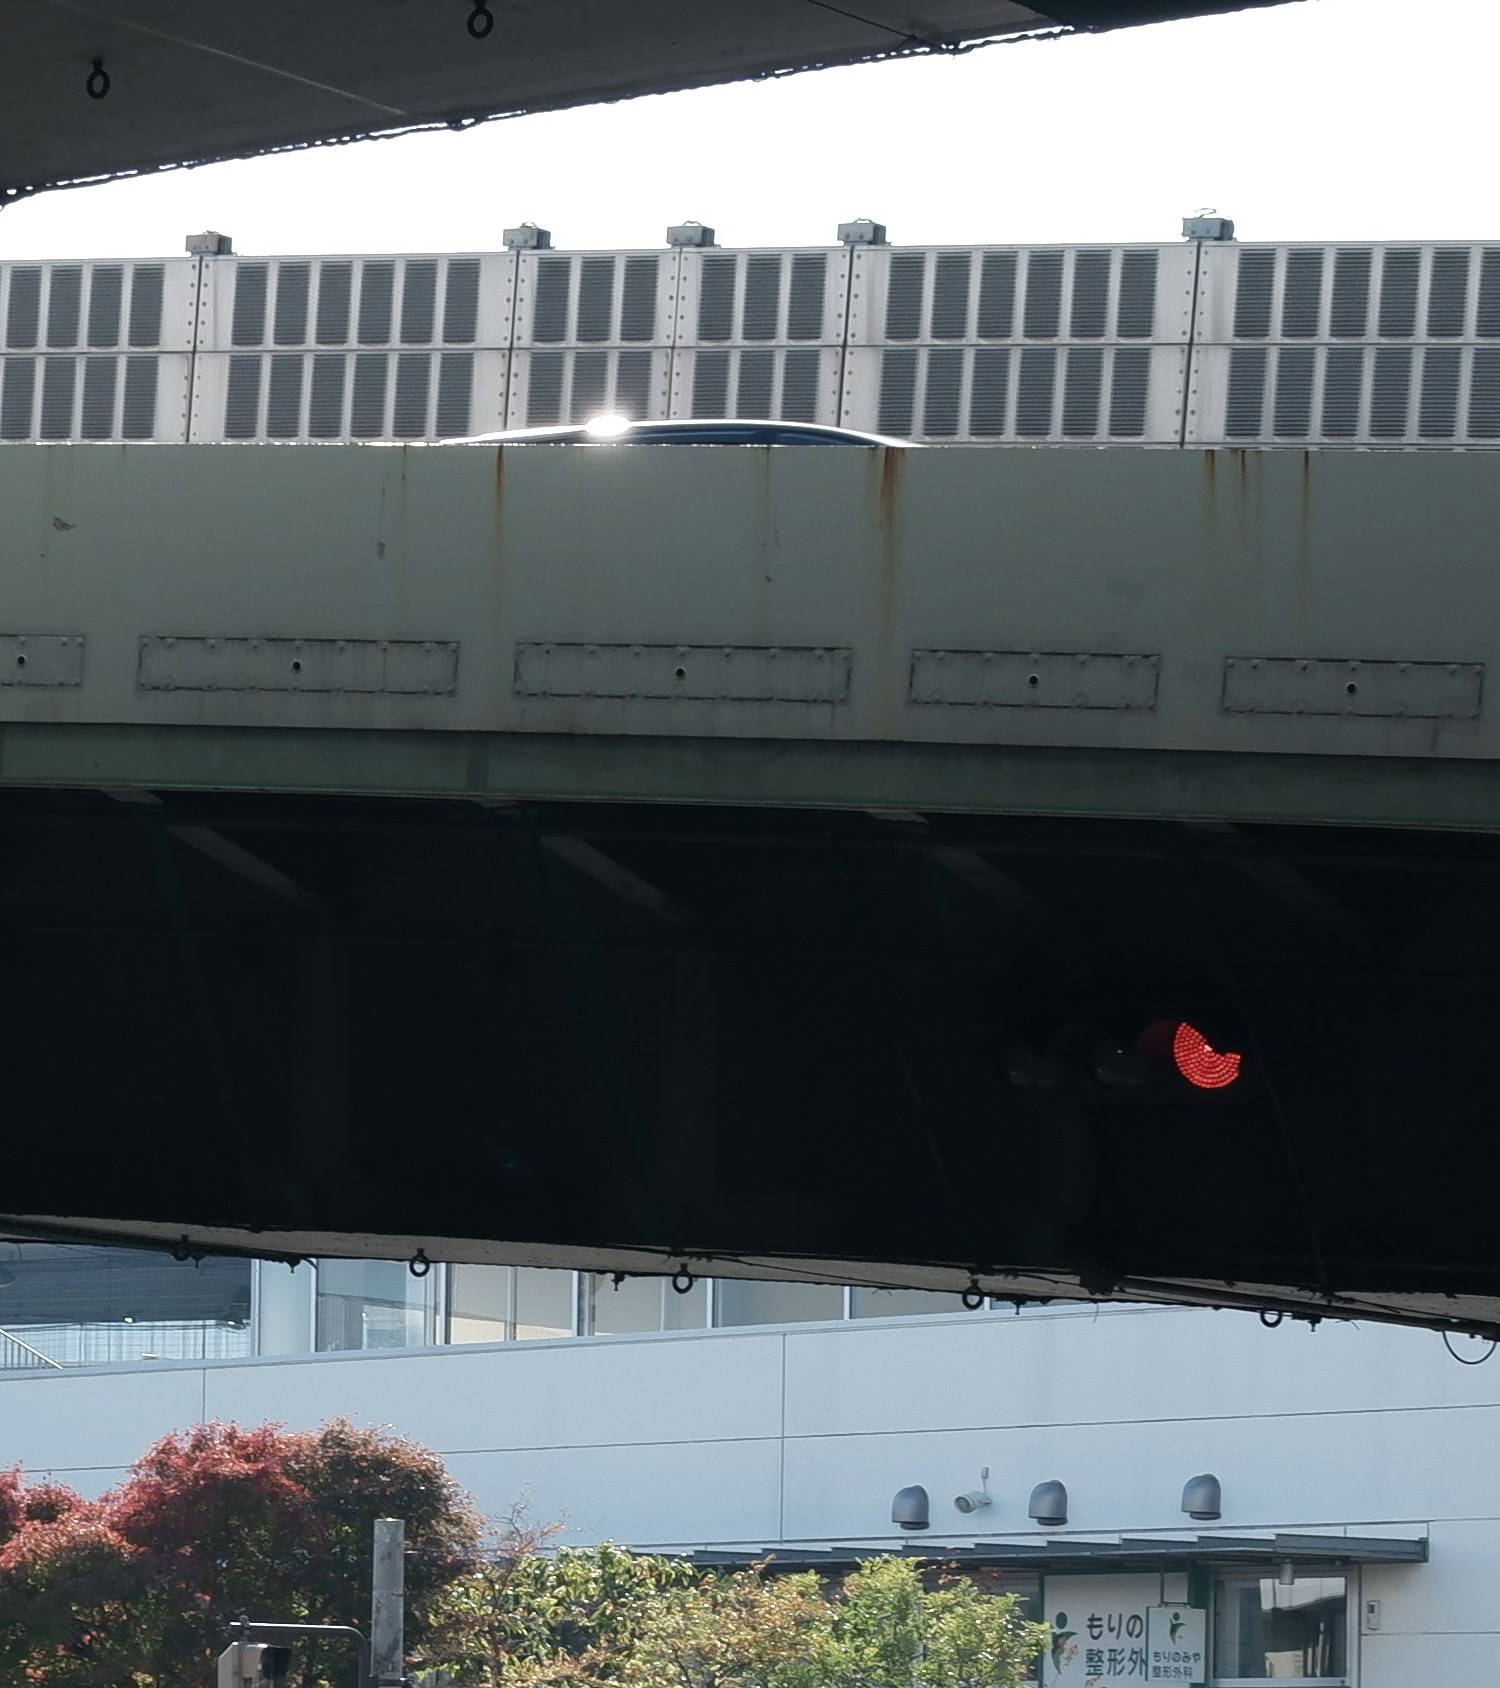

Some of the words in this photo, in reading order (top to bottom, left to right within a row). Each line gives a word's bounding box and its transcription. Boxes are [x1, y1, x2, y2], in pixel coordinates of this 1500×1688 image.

[1086, 1613, 1143, 1641] もりの
[1085, 1647, 1147, 1676] 整形外
[1153, 1650, 1202, 1664] もりのみや
[1151, 1665, 1193, 1680] 整形外科
